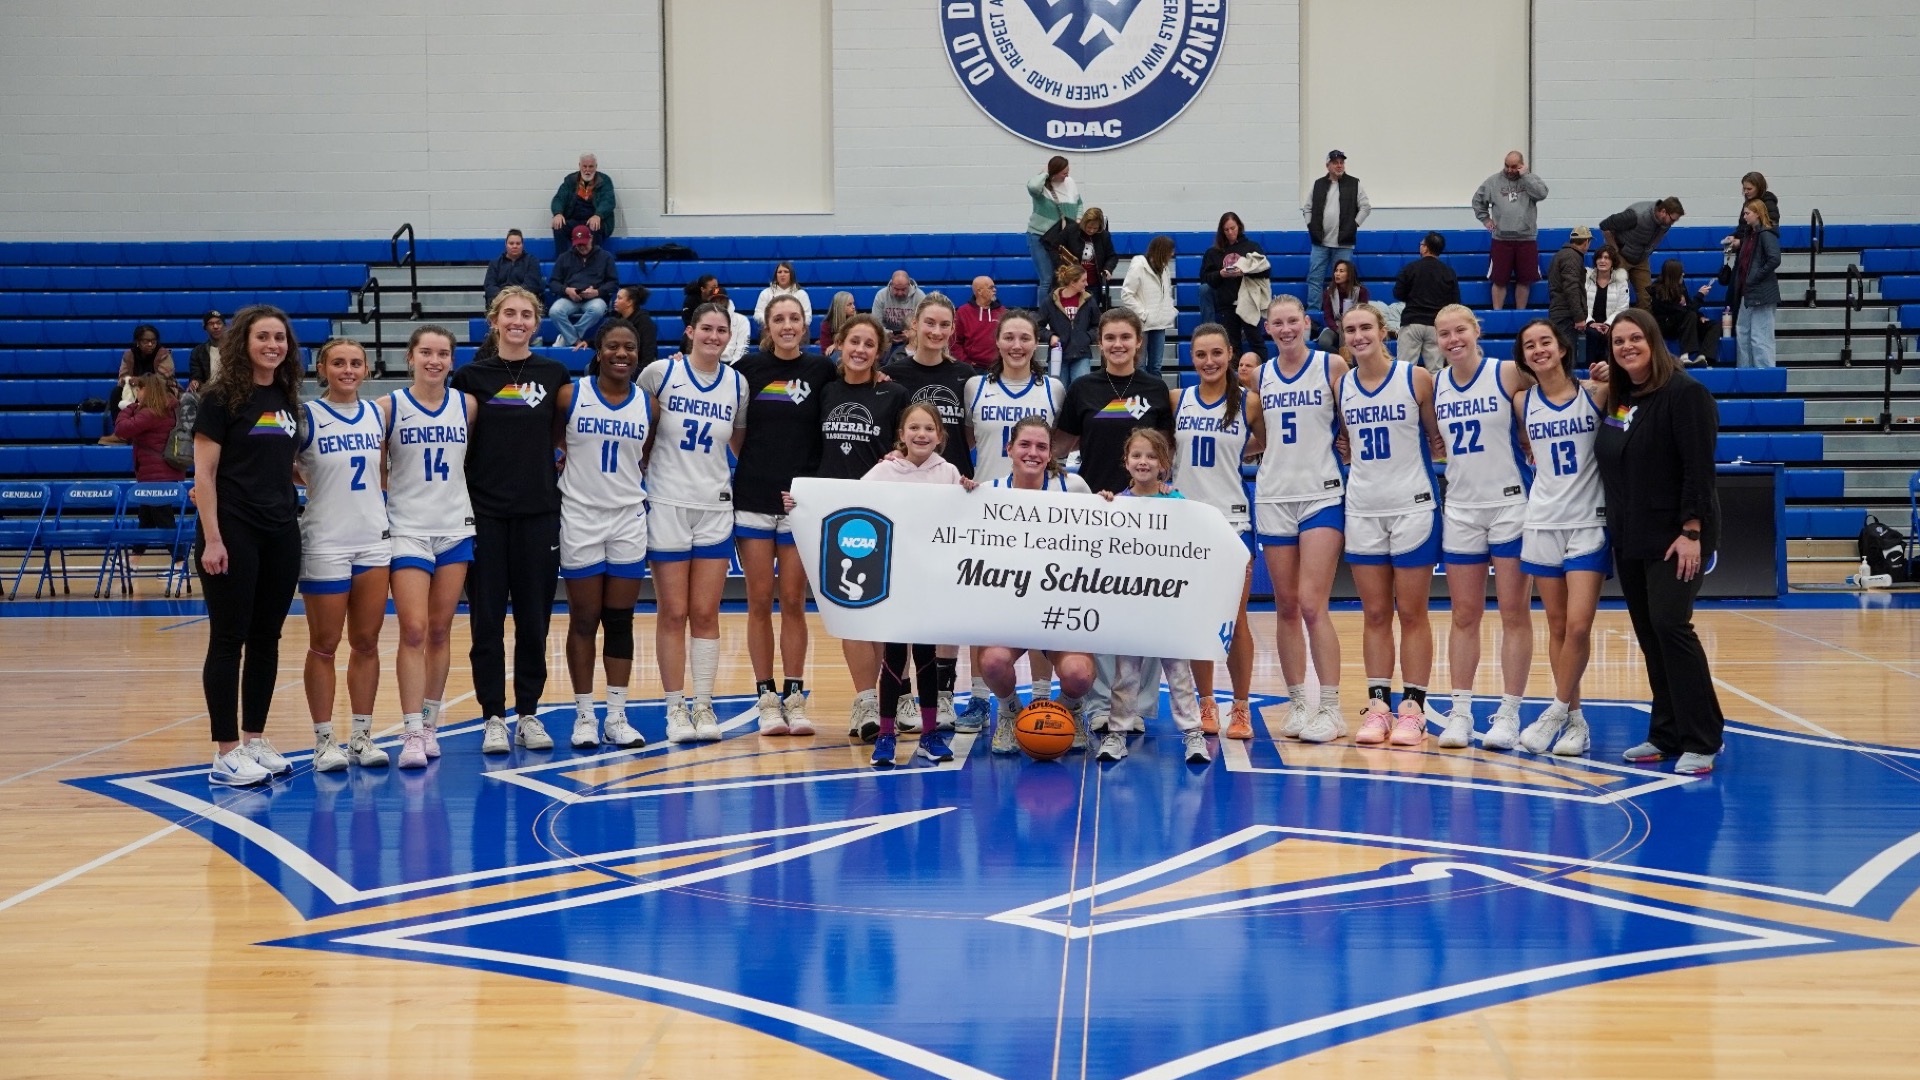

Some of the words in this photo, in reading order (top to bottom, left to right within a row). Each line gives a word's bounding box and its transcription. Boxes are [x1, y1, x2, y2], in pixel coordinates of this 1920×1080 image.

[989, 12, 1024, 69] RESPECT
[952, 32, 995, 86] OLD
[1141, 42, 1168, 71] WIN
[1026, 70, 1063, 97] HARD
[1065, 83, 1109, 100] CHEER
[1121, 65, 1146, 91] DAY
[1046, 118, 1122, 138] ODAC
[667, 395, 733, 422] GENERALS
[1262, 389, 1322, 410] GENERALS
[1437, 396, 1498, 421] GENERALS
[1281, 411, 1297, 444] 5
[1344, 403, 1406, 426] GENERALS
[1528, 415, 1595, 441] GENERALS
[399, 425, 466, 445] GENERALS
[577, 416, 645, 441] GENERALS
[679, 418, 714, 454] 34
[821, 421, 881, 437] GENERALS
[825, 432, 871, 443] BASKETBALL
[1448, 419, 1485, 456] 22
[601, 440, 620, 474] 11
[1191, 435, 1216, 468] 10
[1358, 426, 1392, 461] 30
[424, 447, 450, 482] 14
[1550, 440, 1578, 476] 13
[350, 456, 367, 491] 2
[2, 490, 43, 499] GENERALS
[69, 489, 113, 498] GENERALS
[134, 488, 178, 497] GENERALS
[982, 502, 1042, 523] NCAA
[1047, 506, 1142, 530] DIVISION
[1148, 513, 1168, 531] III
[841, 536, 876, 549] NCAA
[931, 526, 1017, 549] All-Time
[1023, 531, 1103, 559] Leading
[1108, 536, 1212, 560] Rebounder
[956, 557, 1032, 598] Mary
[1039, 562, 1189, 599] Schleusner
[1040, 605, 1100, 633] #50
